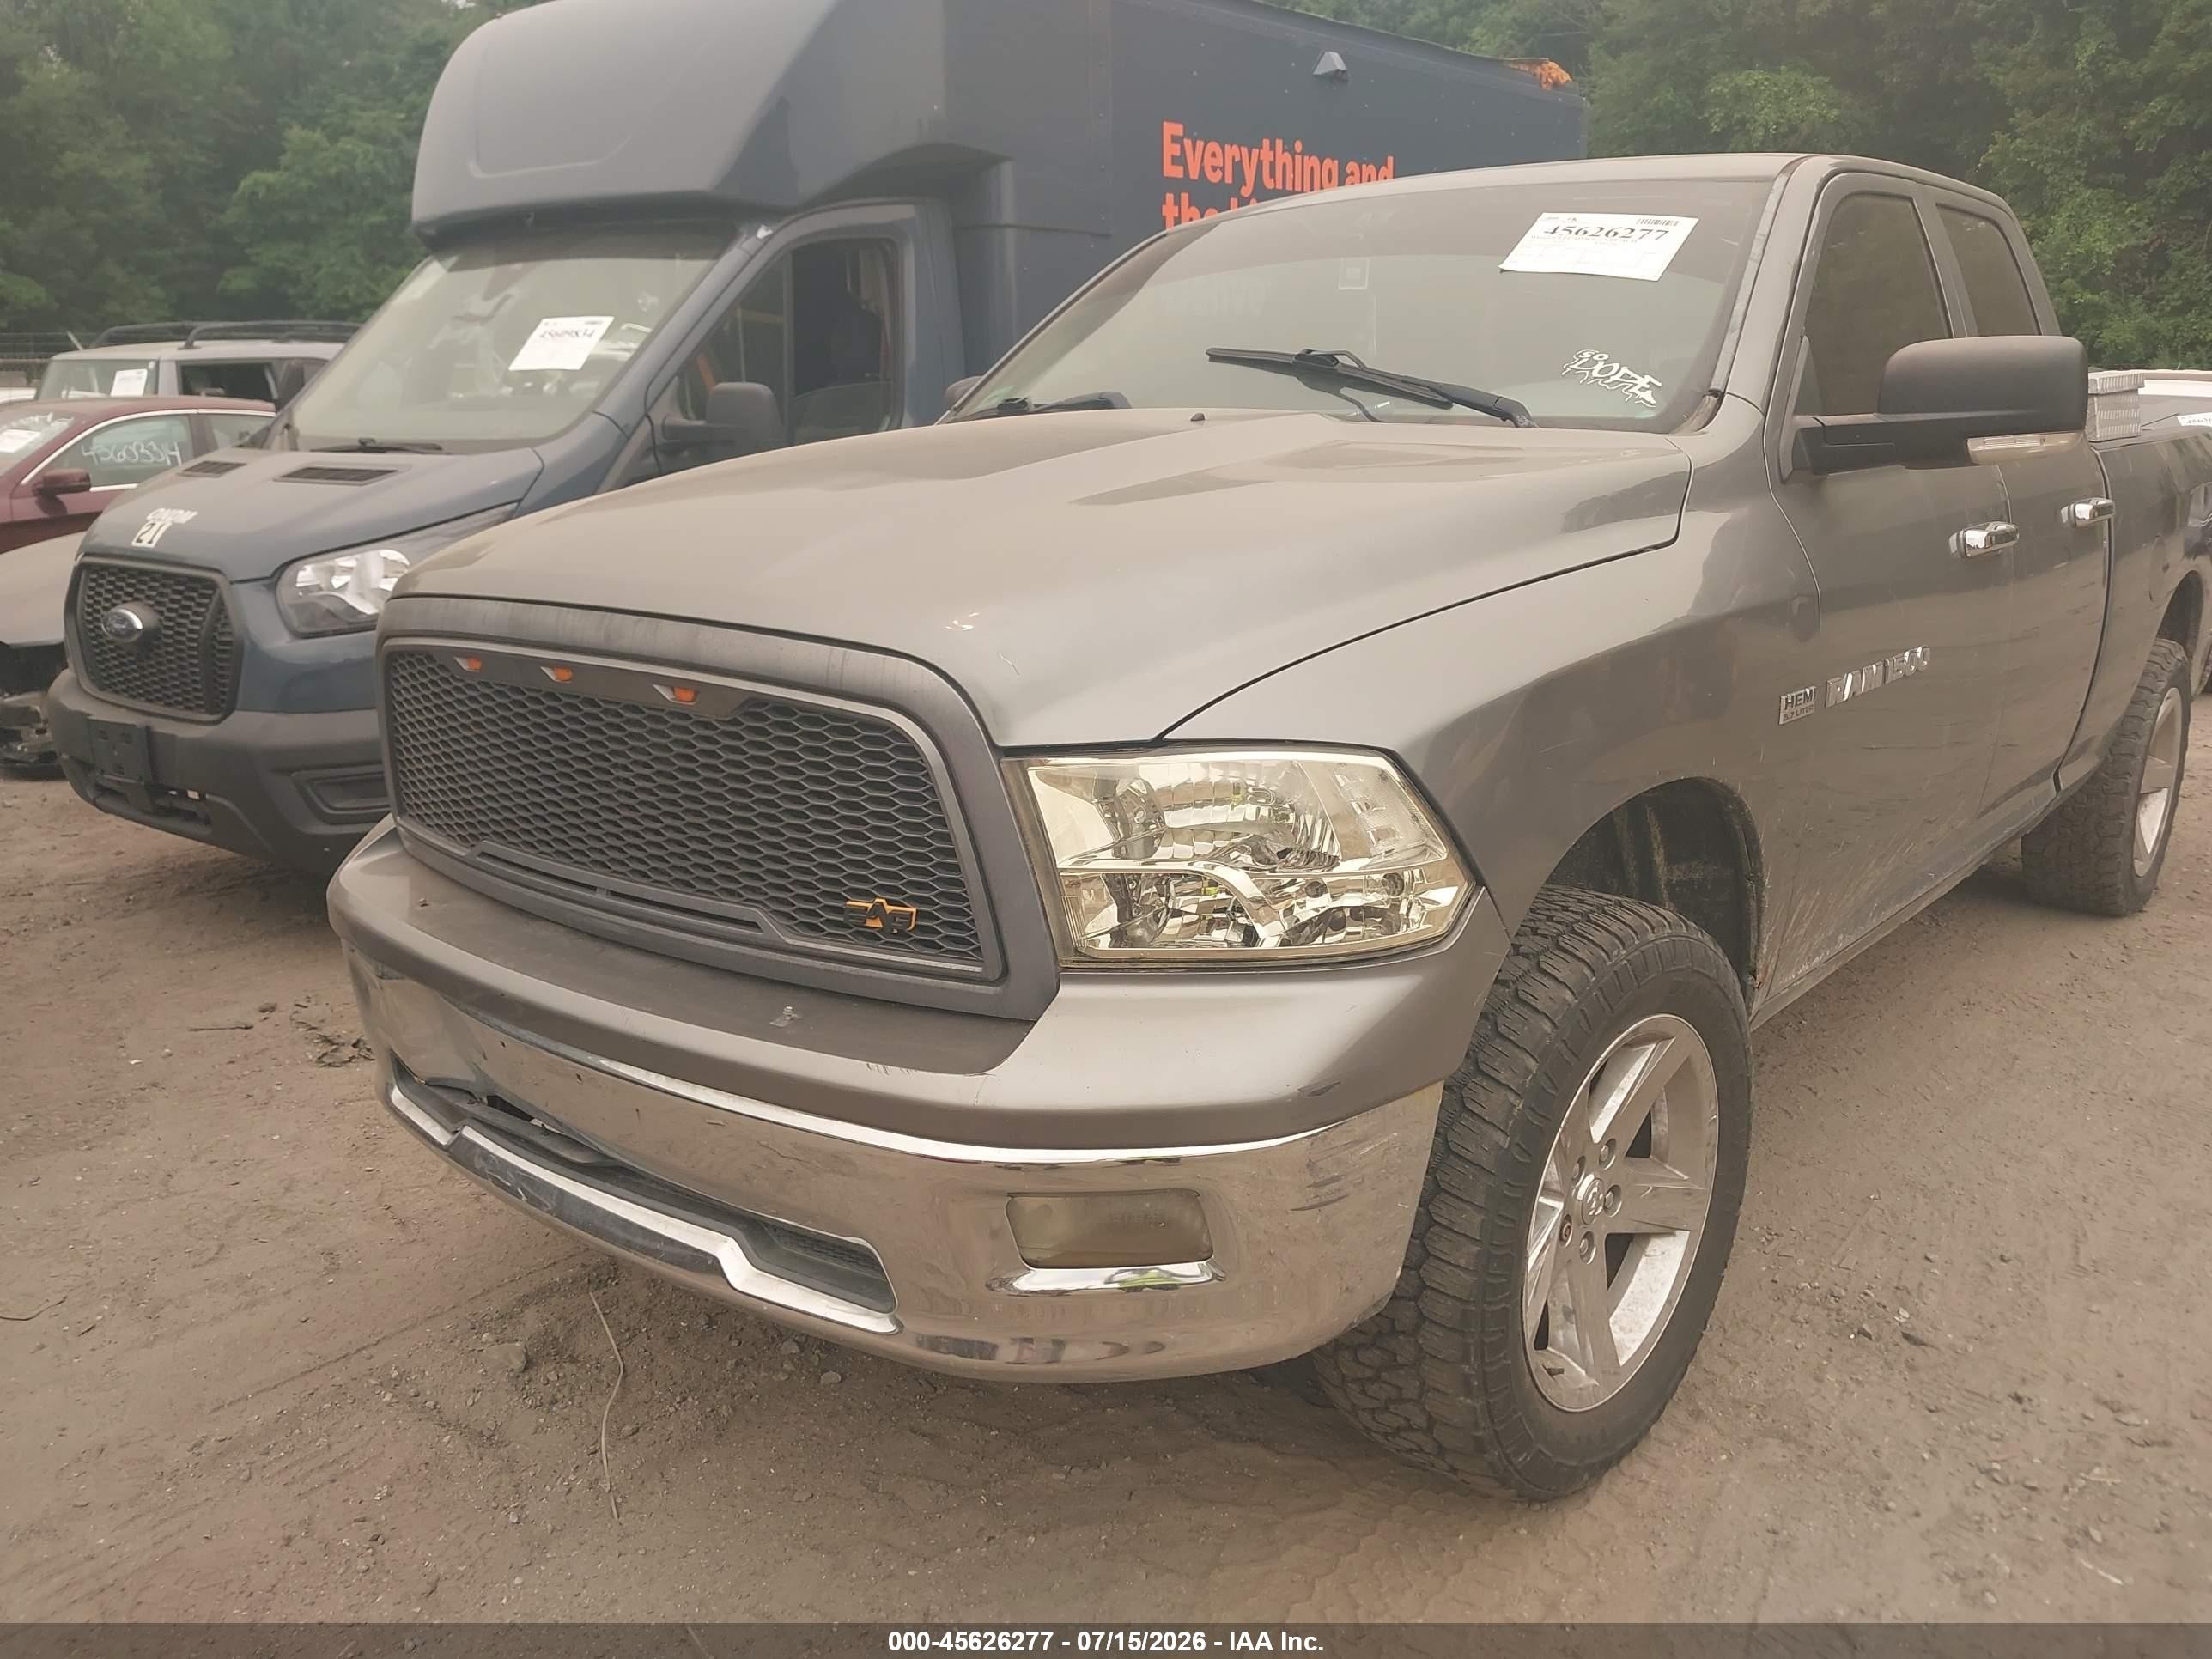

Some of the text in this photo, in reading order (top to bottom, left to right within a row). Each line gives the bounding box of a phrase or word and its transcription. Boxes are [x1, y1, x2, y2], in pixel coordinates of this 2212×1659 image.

[1162, 120, 1395, 198] Everything and
[1162, 191, 1224, 230] th
[1543, 225, 1670, 241] 45626277
[1825, 645, 1931, 708] RAM 1500
[1784, 687, 1817, 711] HEMI
